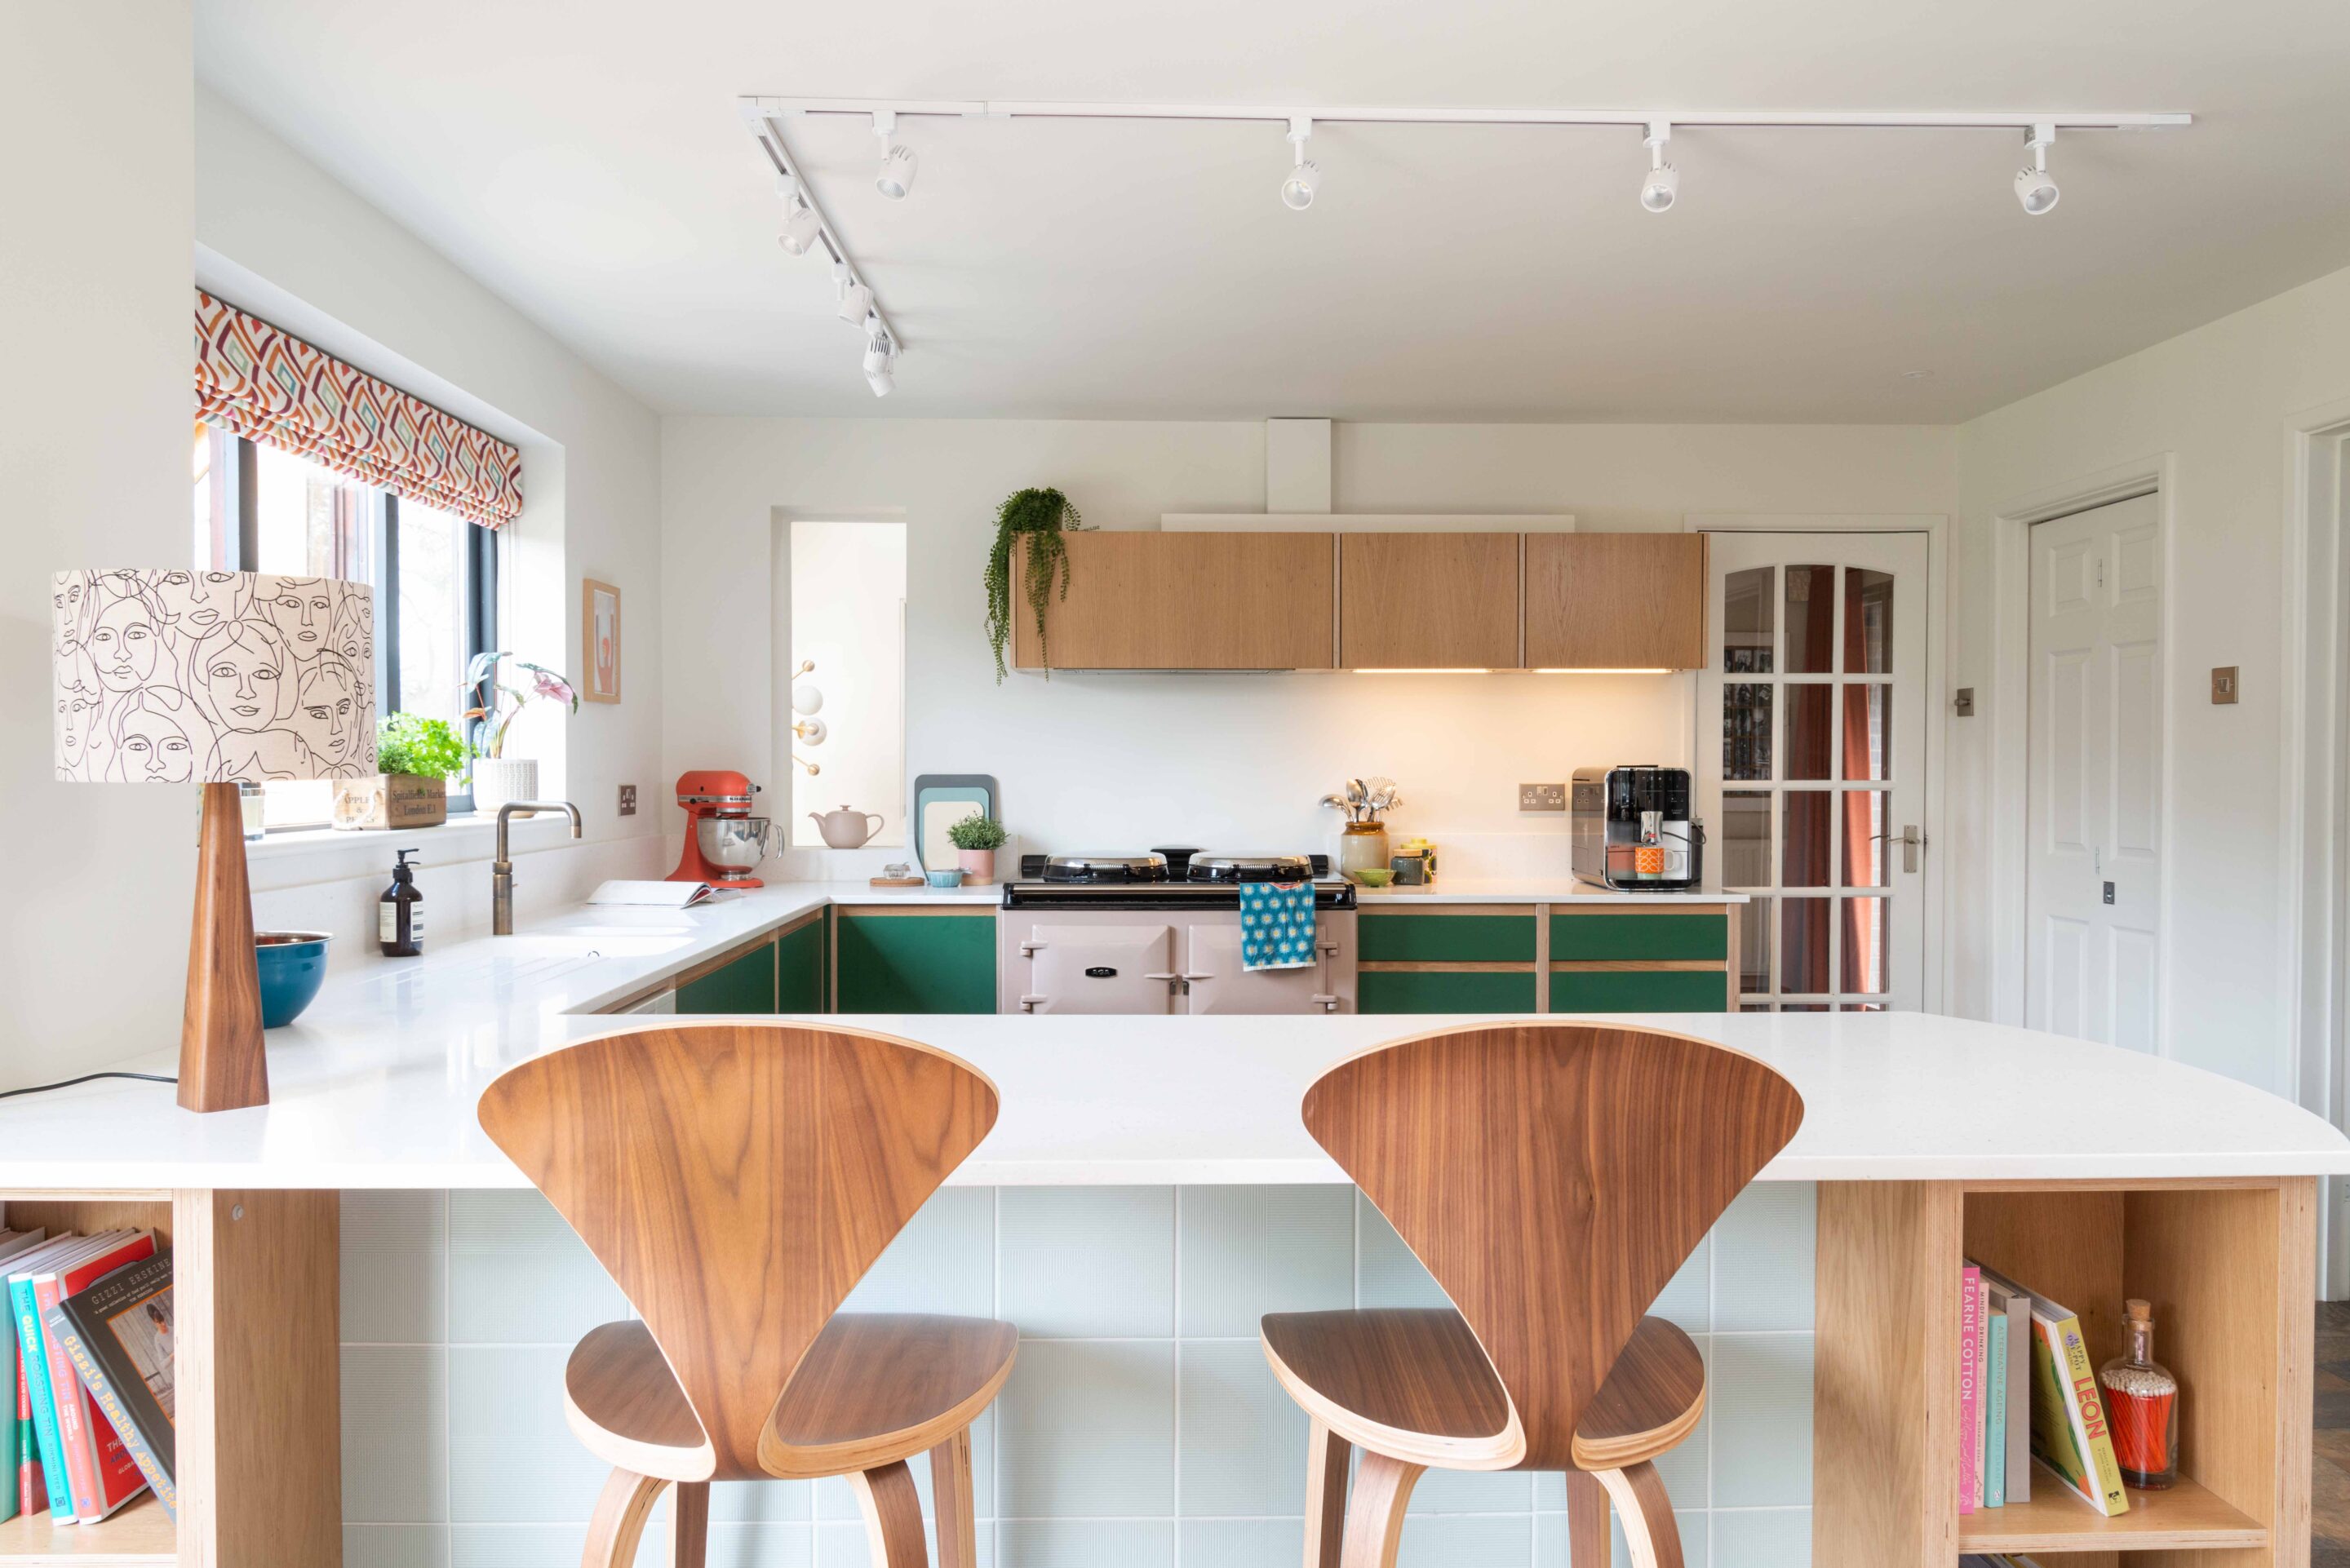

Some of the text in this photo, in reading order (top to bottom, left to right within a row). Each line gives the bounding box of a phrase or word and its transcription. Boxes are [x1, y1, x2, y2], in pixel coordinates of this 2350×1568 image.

[404, 804, 426, 816] London
[91, 1257, 171, 1305] GIZZI ERSKINE
[1962, 1278, 1975, 1400] FEARNE COTTON
[2067, 1334, 2082, 1371] ONE-POT
[2073, 1337, 2086, 1365] HAPPY
[19, 1288, 53, 1437] THE QUICK ROASTING TIN
[60, 1380, 73, 1401] TIN
[2073, 1376, 2107, 1440] LEON
[62, 1404, 75, 1442] THE WORLD
[64, 1335, 177, 1508] Gizzi's Healthy Appetite
[68, 1403, 79, 1430] AROUND
[107, 1437, 122, 1452] THE
